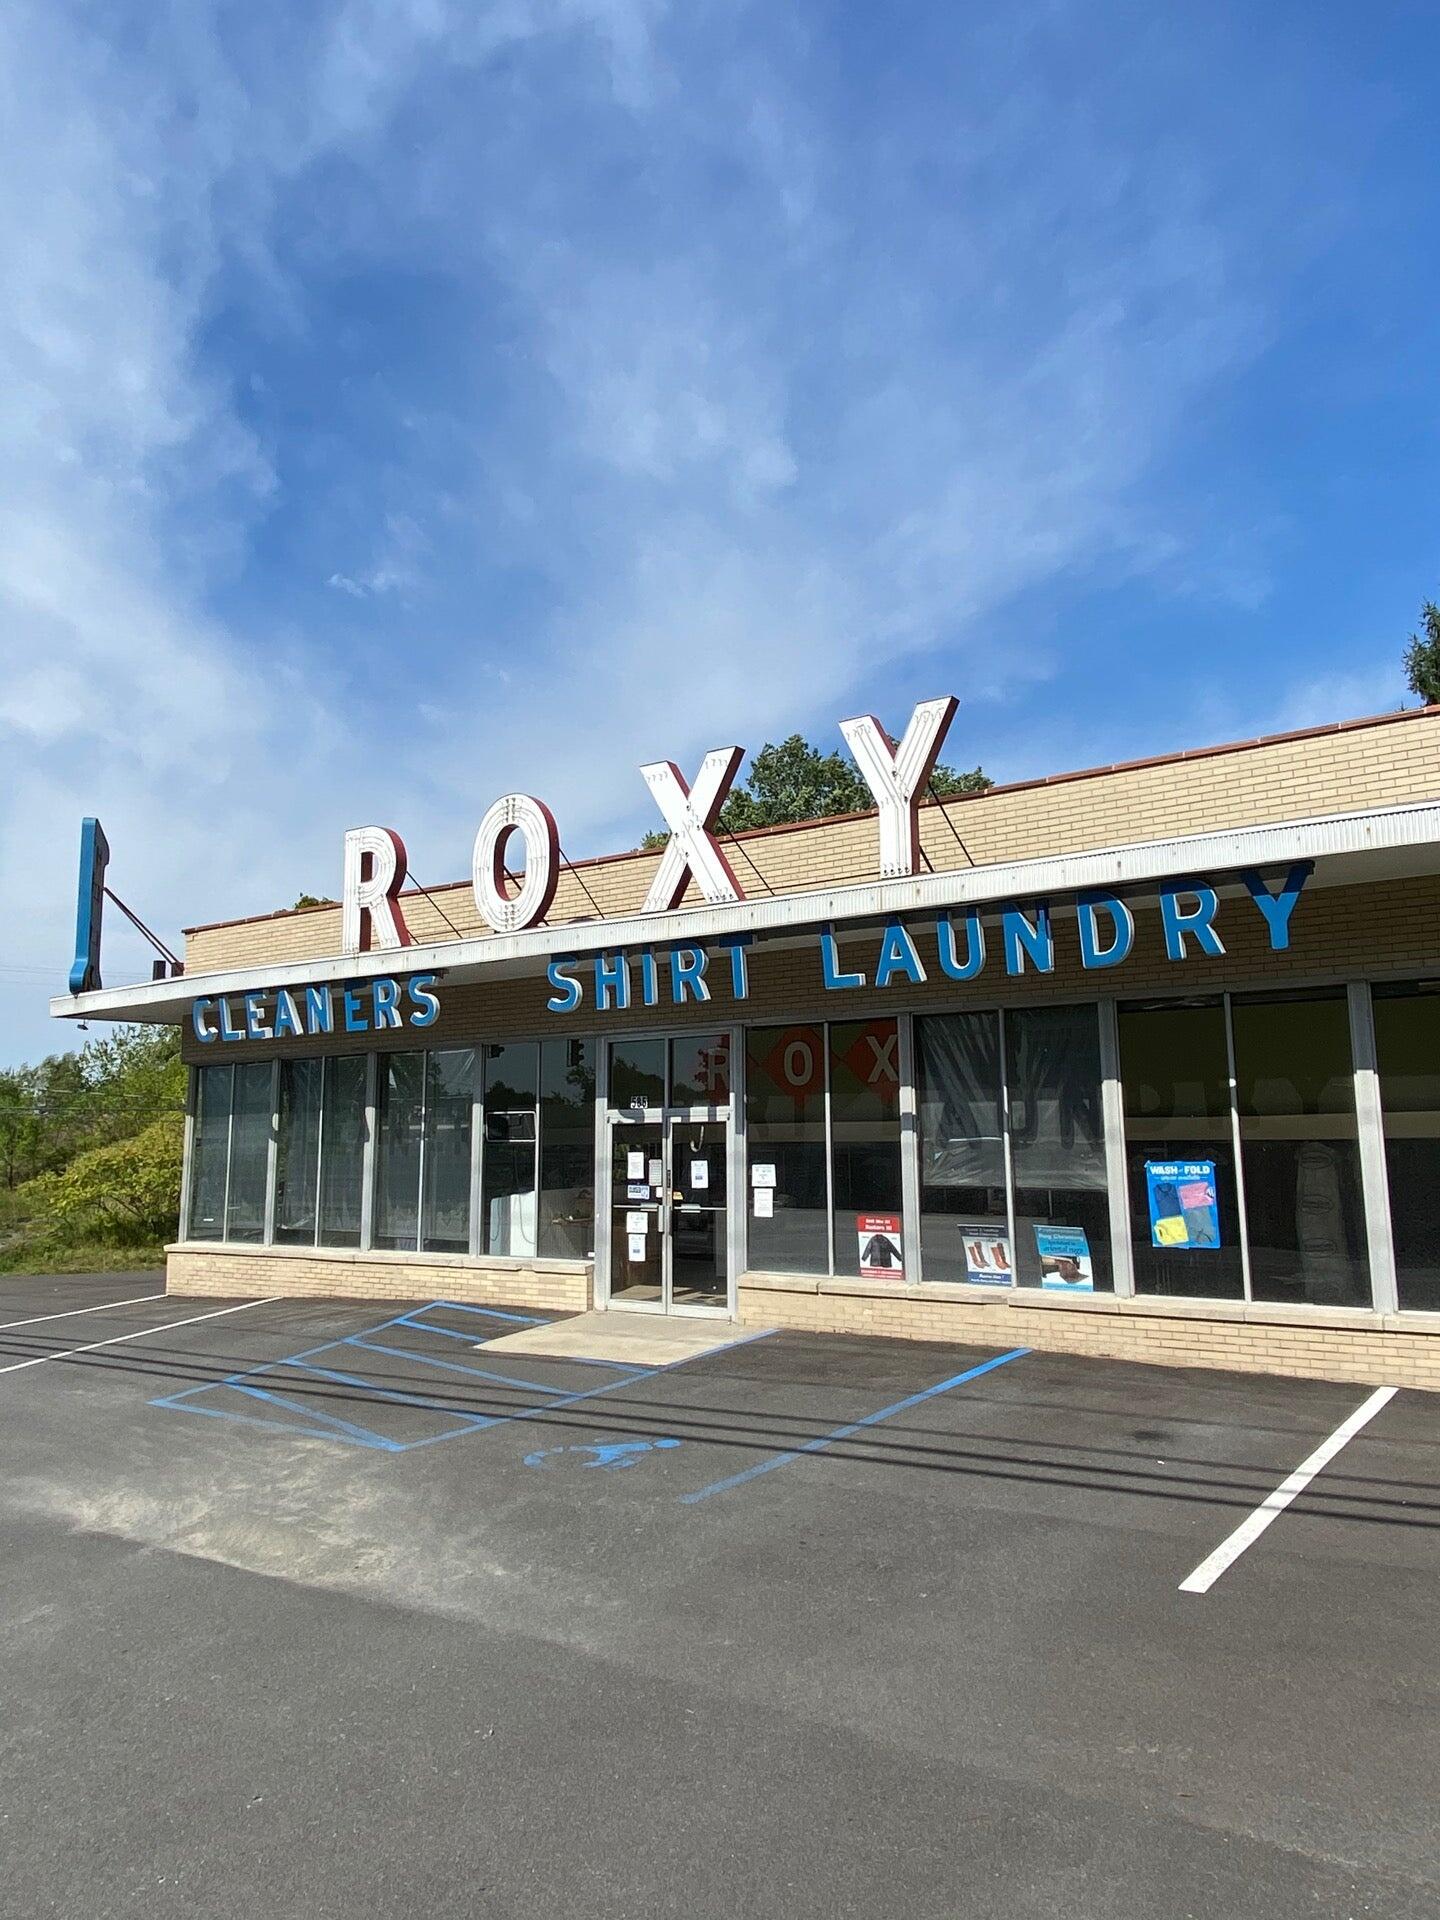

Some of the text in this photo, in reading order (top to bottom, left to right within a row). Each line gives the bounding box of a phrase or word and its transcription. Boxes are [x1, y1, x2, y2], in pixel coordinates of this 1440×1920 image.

[342, 696, 960, 952] ROXY
[545, 862, 1313, 1014] SHIRT LAUNDRY
[191, 974, 441, 1043] CLEANERS
[1150, 1166, 1178, 1175] WASH
[1184, 1165, 1210, 1175] FOLD
